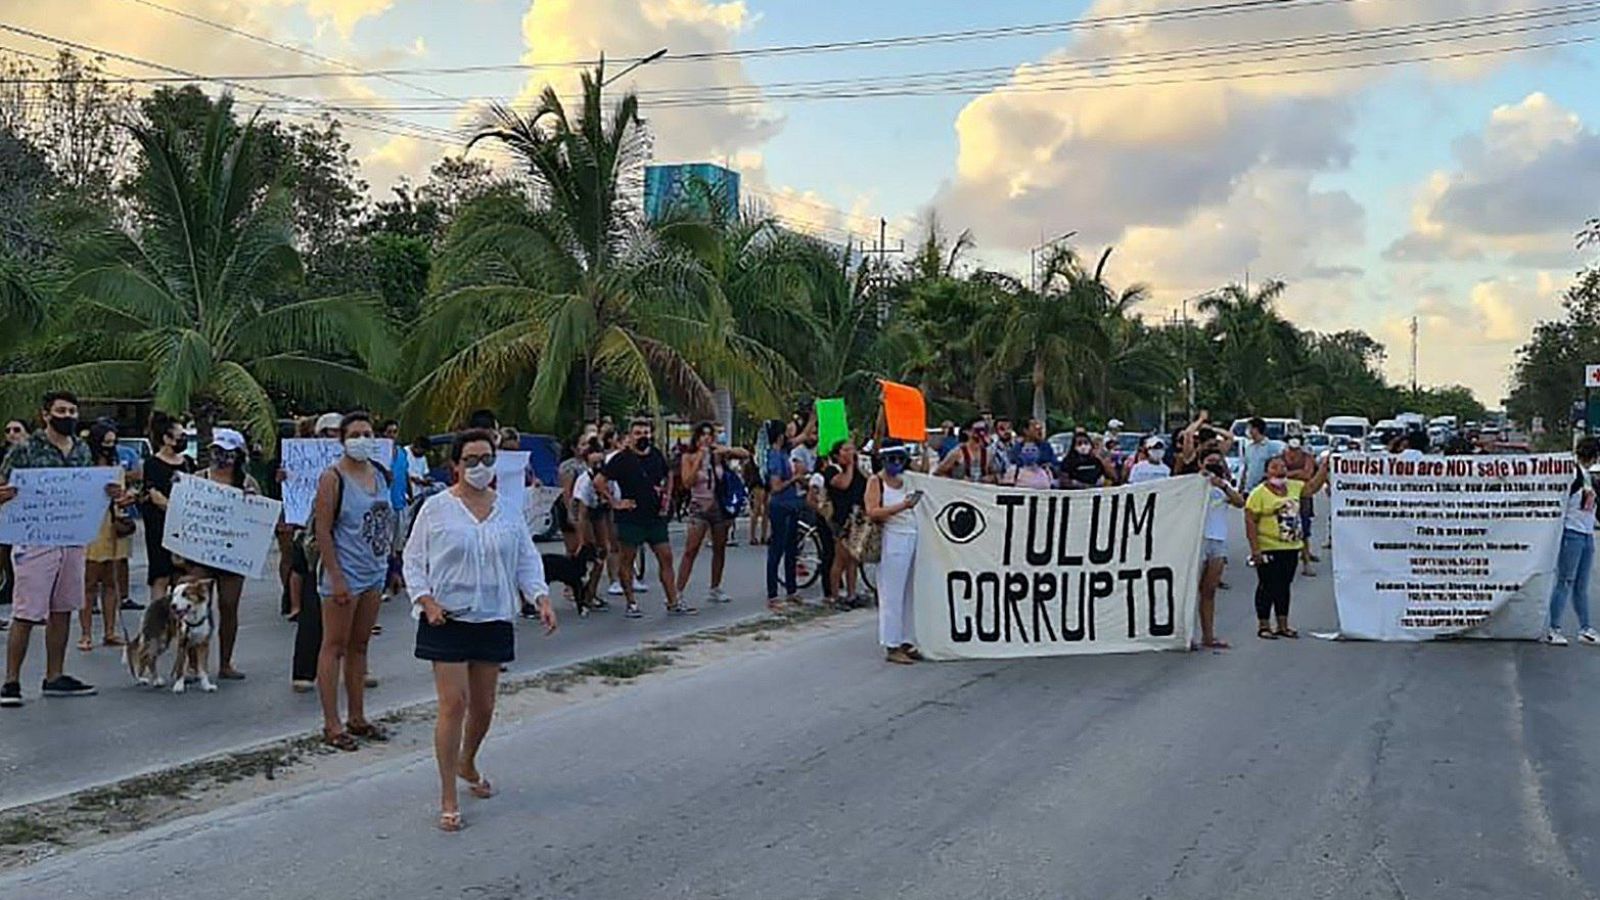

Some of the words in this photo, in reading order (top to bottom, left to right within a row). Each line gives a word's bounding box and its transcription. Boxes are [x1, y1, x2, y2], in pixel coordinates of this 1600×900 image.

[1333, 456, 1384, 475] Tourist
[1388, 458, 1415, 476] You
[1417, 460, 1444, 477] are
[1446, 459, 1473, 477] NOT
[1477, 459, 1509, 478] safe
[1512, 458, 1527, 476] in
[996, 492, 1157, 567] TULUM
[947, 566, 1175, 644] CORRUPTO
